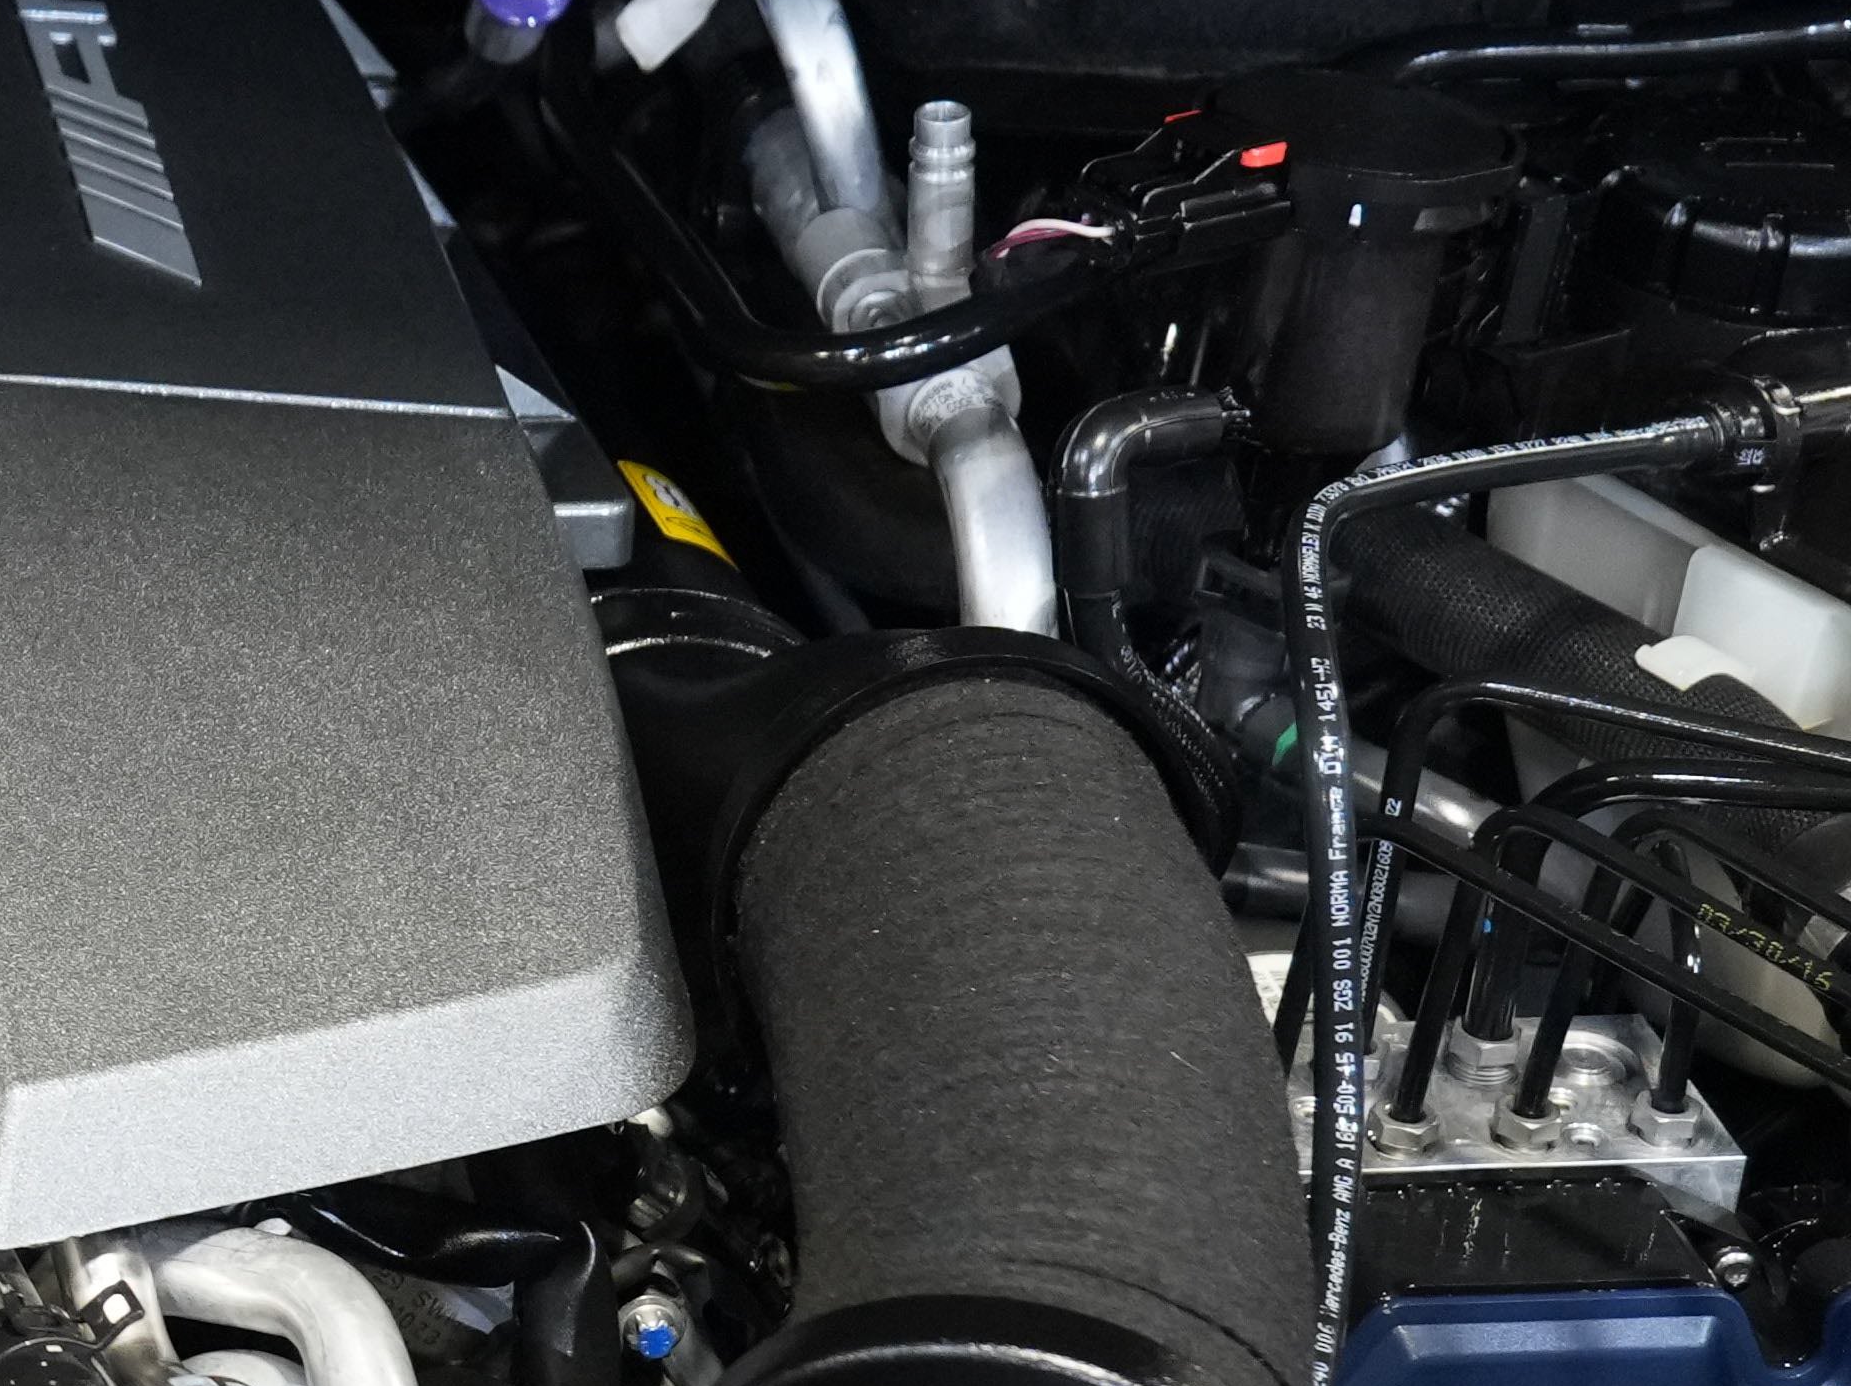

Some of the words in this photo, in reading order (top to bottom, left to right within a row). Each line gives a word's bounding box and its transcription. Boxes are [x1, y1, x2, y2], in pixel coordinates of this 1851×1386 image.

[1328, 786, 1348, 862] France
[1331, 870, 1349, 928] NORMA
[1332, 937, 1352, 970] 001
[1334, 979, 1353, 1013] ZGS
[1335, 1021, 1355, 1044] 91
[1335, 1157, 1355, 1172] A
[1332, 1174, 1354, 1204] AMG
